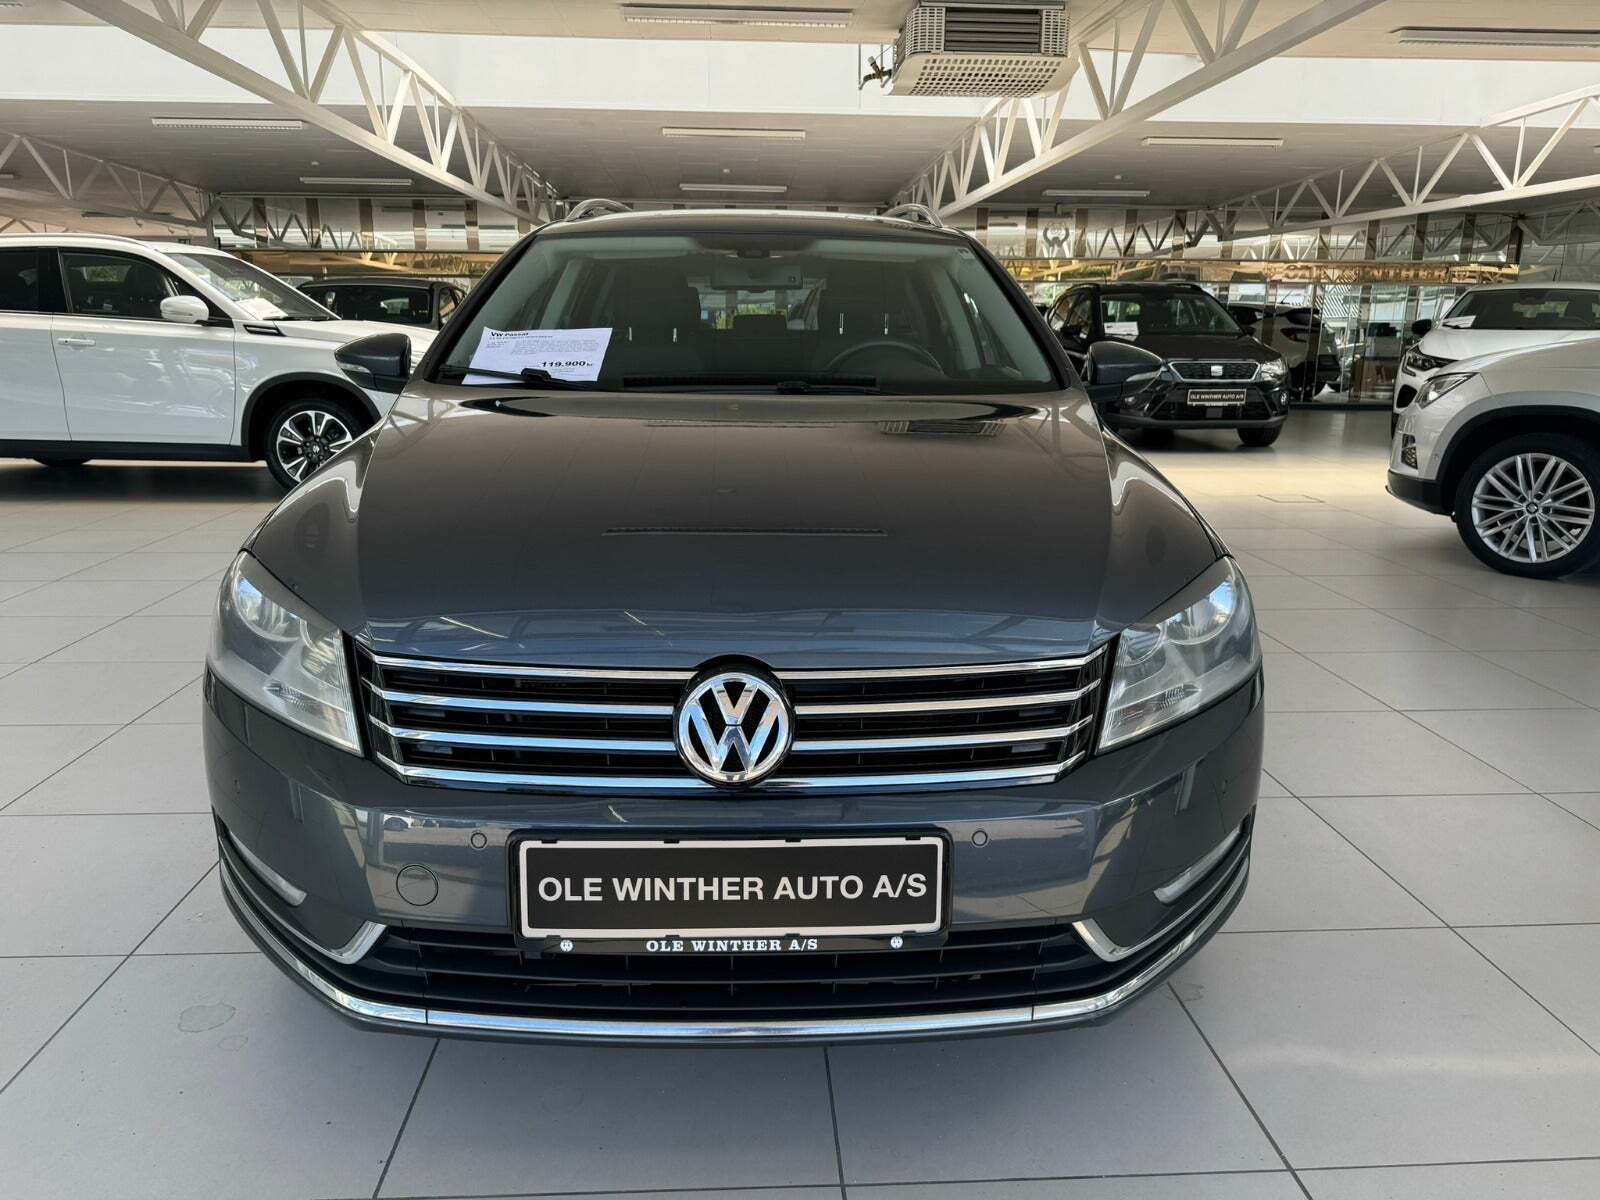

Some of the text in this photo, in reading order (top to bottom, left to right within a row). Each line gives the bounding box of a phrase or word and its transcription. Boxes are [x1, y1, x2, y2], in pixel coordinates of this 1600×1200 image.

[541, 360, 586, 368] 119.900
[538, 873, 927, 902] OLE WINTHER AUTO A/S
[645, 938, 819, 953] OLE WINTHER A/S
